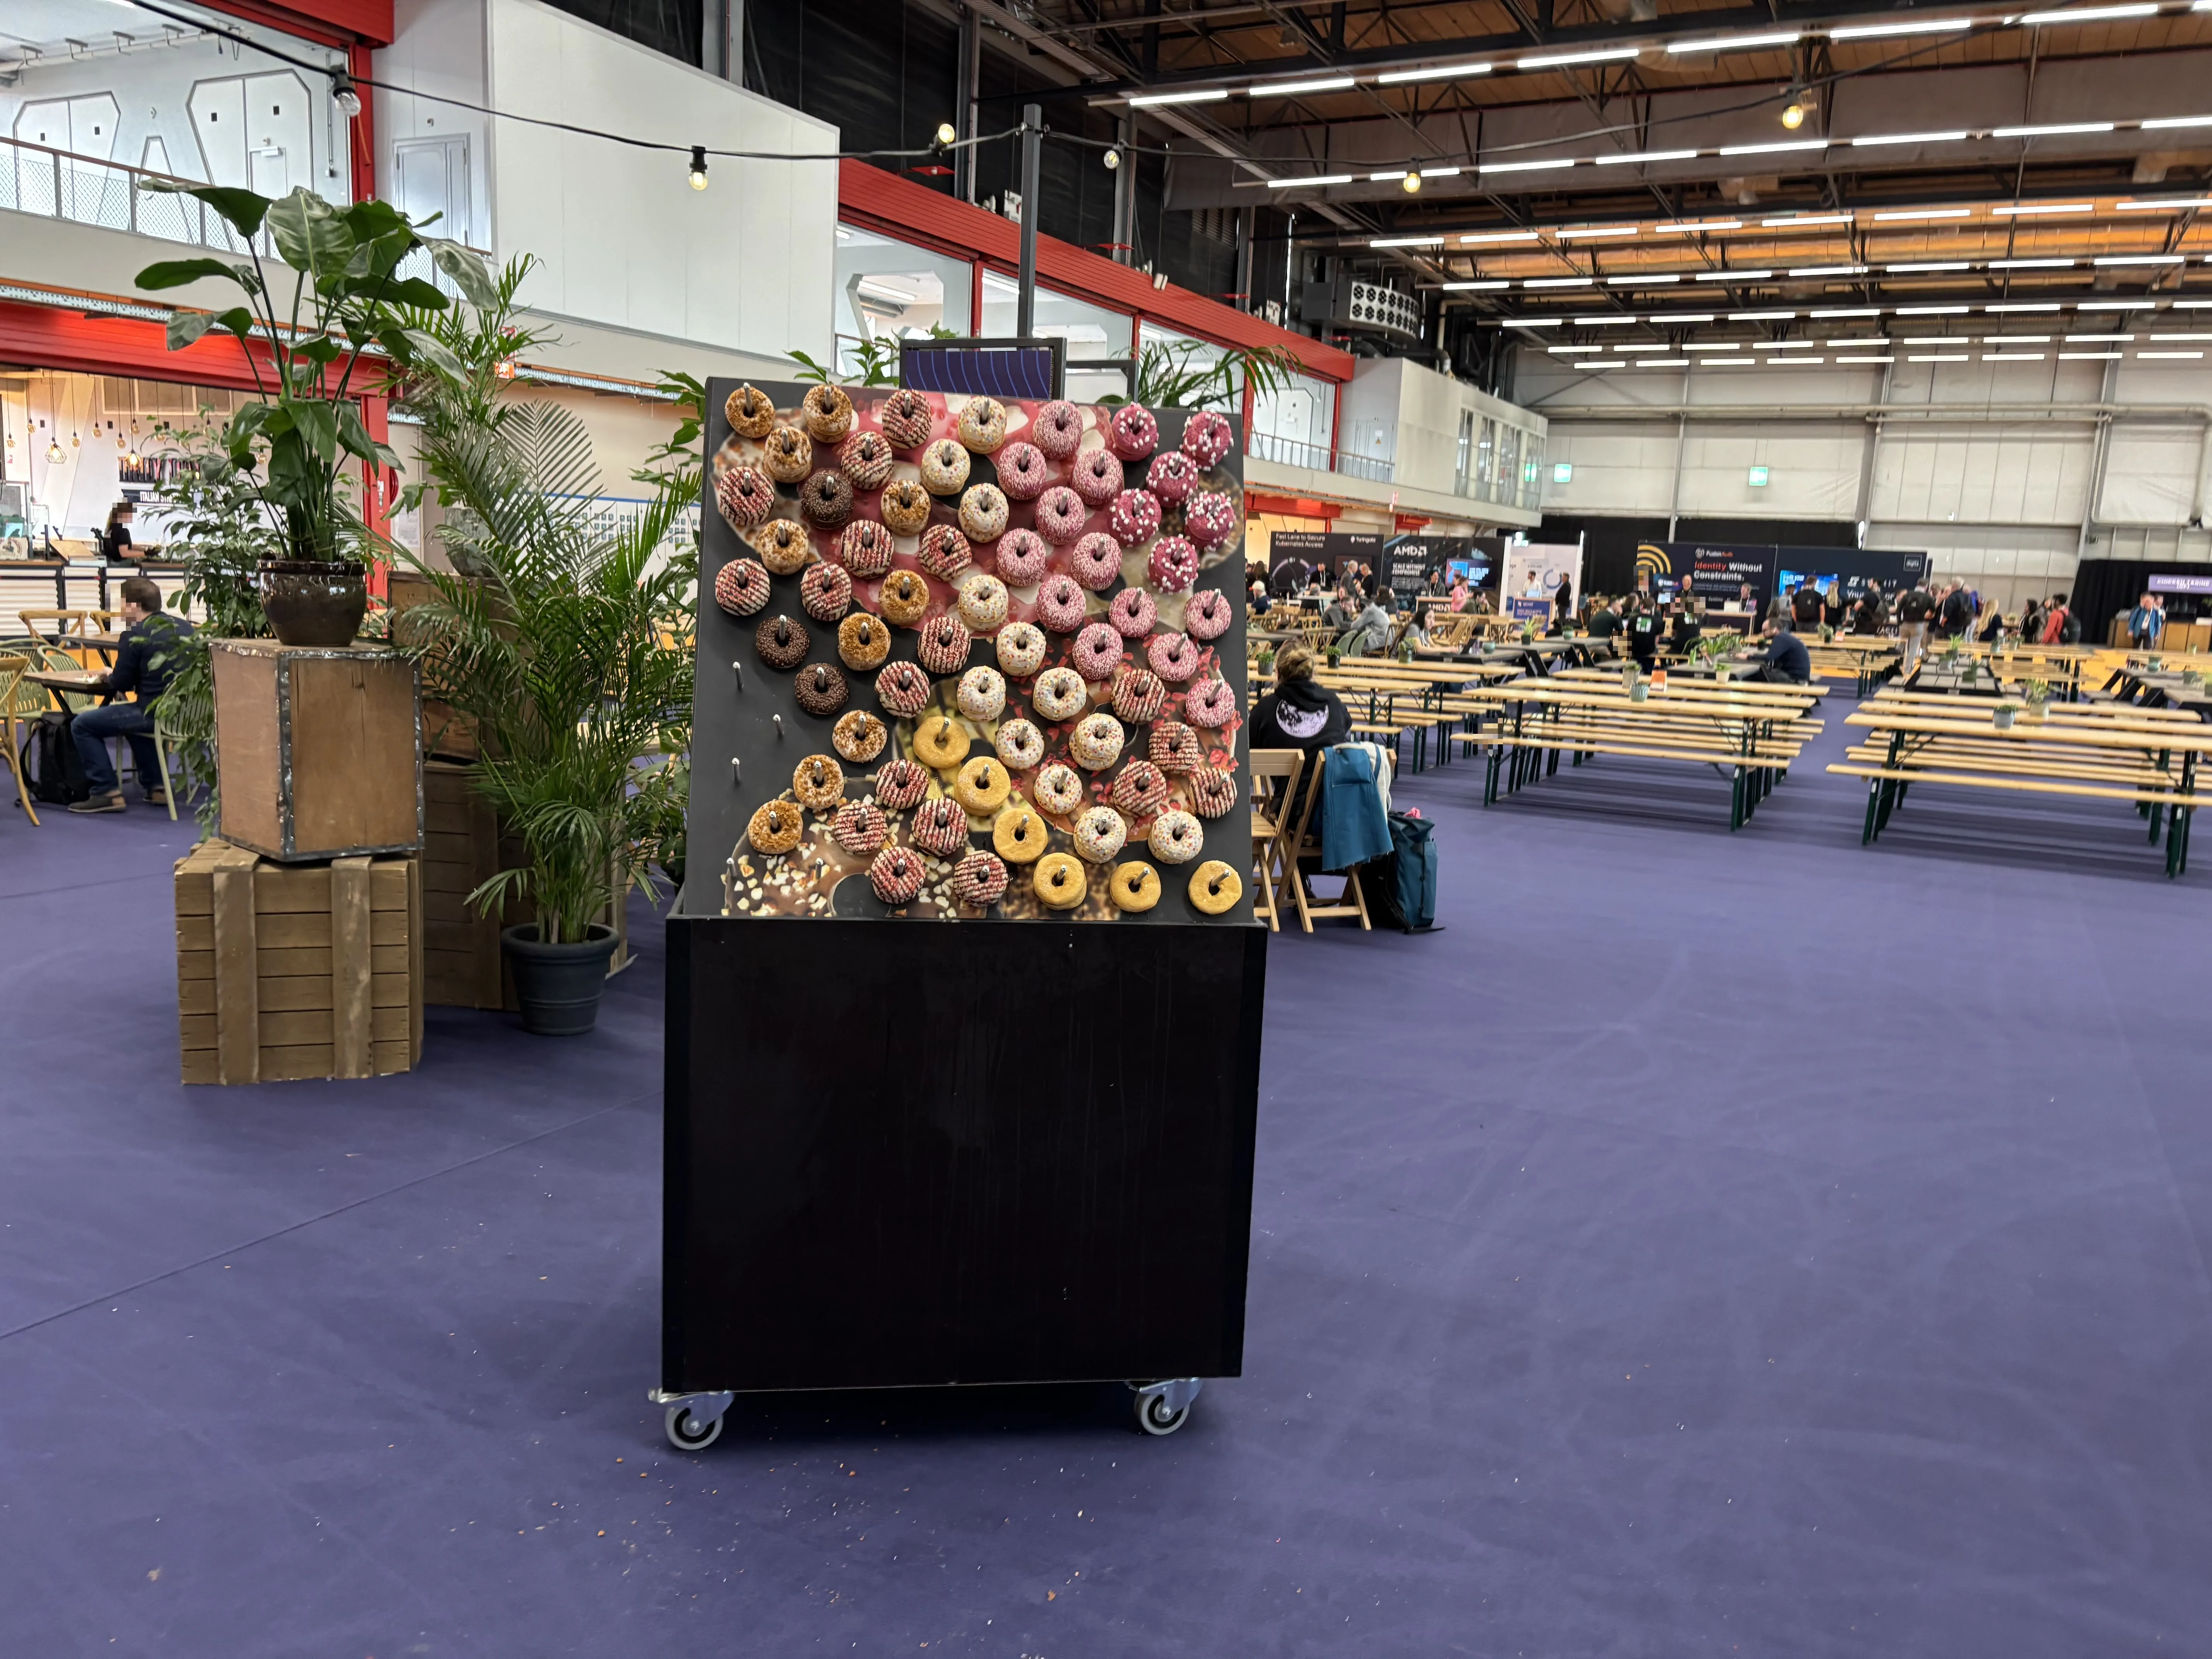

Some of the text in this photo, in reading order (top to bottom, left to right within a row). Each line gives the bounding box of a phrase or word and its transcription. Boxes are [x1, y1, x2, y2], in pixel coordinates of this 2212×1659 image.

[140, 491, 159, 503] ITALIAN
[1394, 545, 1418, 556] AMD
[1695, 561, 1762, 573] Identity Without
